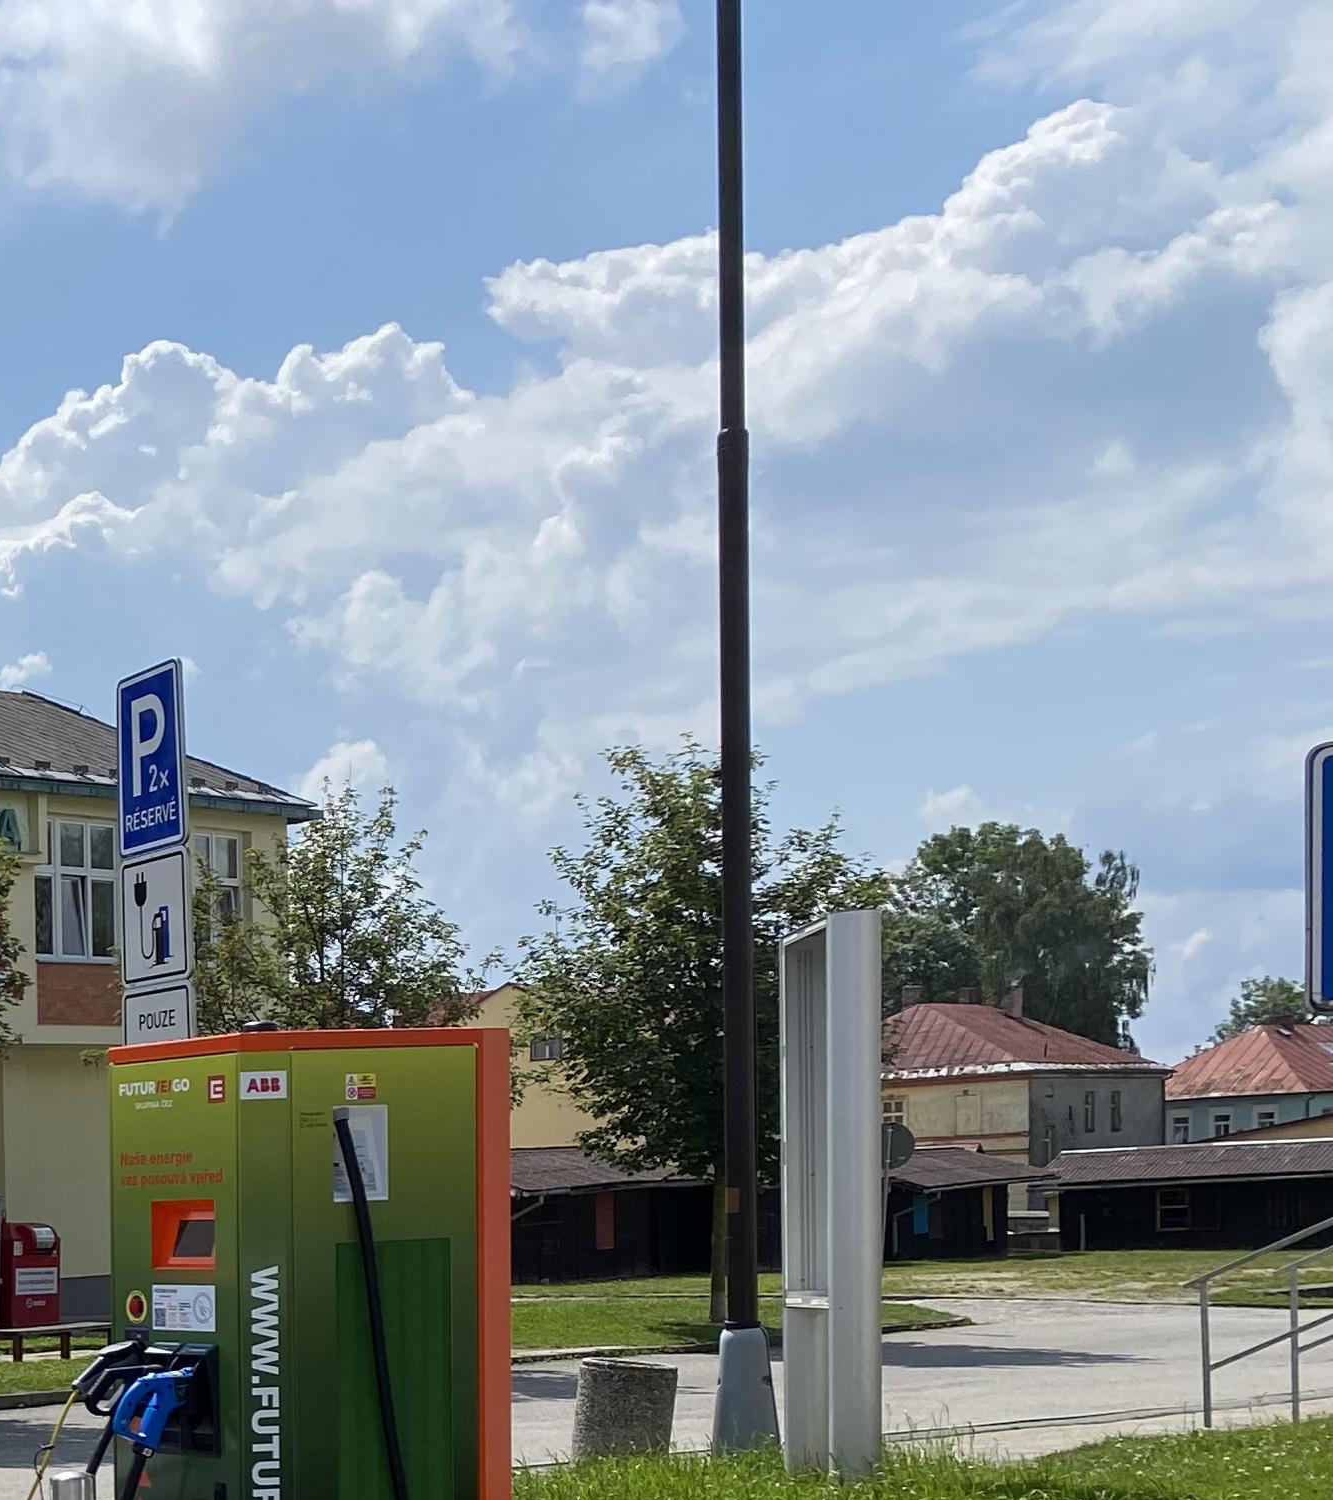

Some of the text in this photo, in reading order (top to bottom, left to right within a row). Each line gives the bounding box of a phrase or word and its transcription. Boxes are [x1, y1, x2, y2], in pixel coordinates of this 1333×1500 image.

[131, 694, 165, 797] P
[149, 764, 169, 792] 2x
[125, 796, 176, 833] RÉSERVÉ
[139, 1009, 175, 1031] POUZE
[246, 1077, 281, 1093] ABB
[150, 1151, 193, 1168] energie
